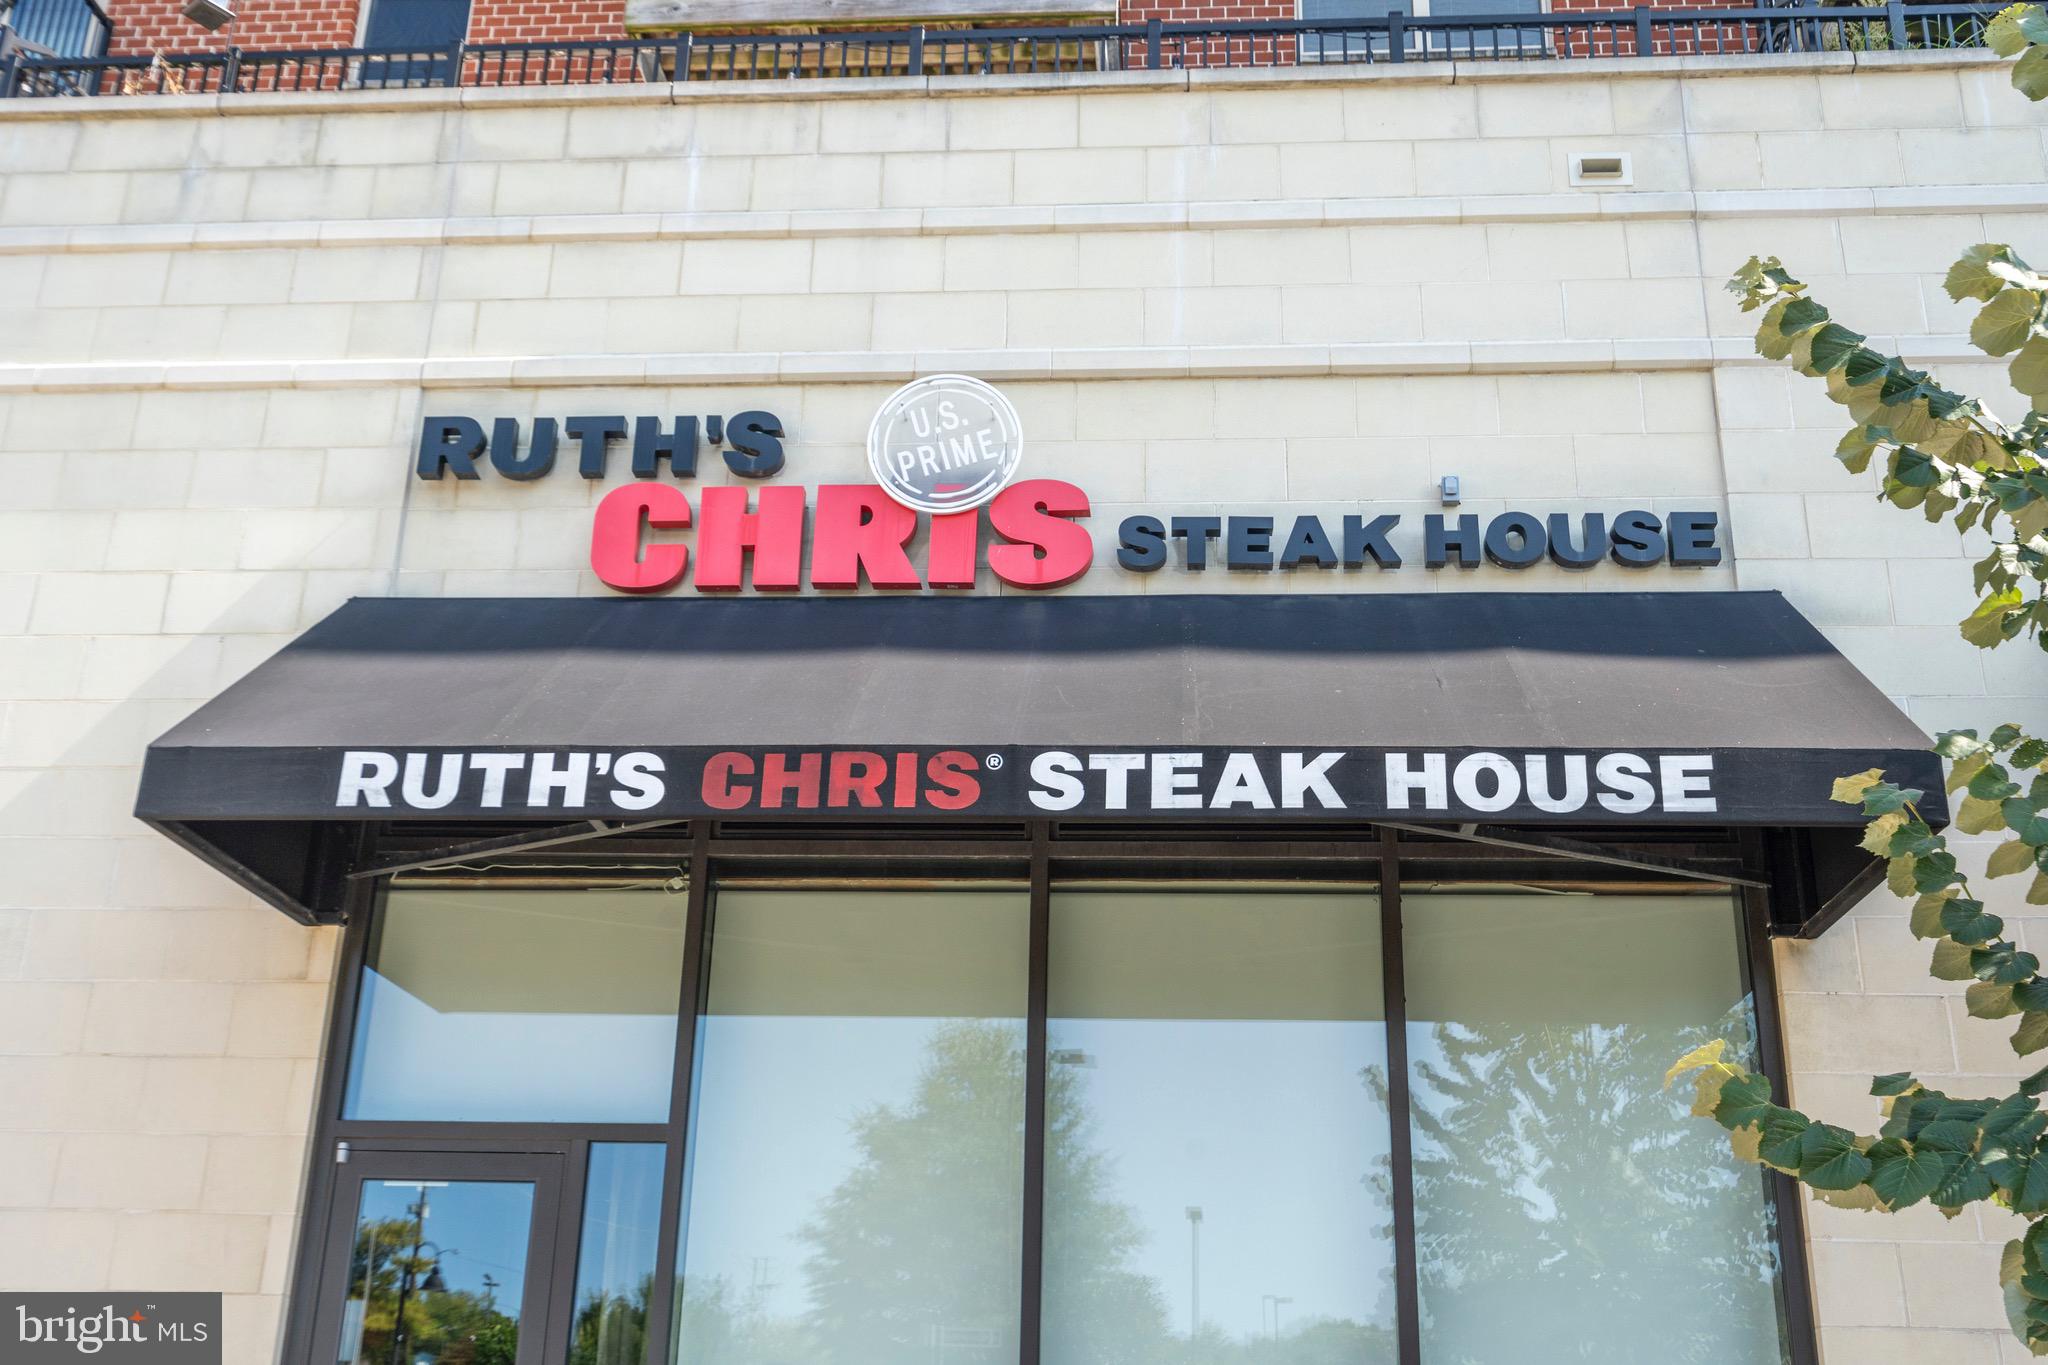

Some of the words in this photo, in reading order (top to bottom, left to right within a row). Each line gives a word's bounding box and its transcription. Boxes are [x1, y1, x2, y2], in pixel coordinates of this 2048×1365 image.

[417, 410, 786, 481] RUTH'S
[910, 401, 969, 438] U.S.
[897, 428, 999, 483] PRIME
[590, 478, 1092, 592] CHRIS
[1117, 514, 1402, 572] STEAK
[1424, 510, 1722, 569] HOUSE
[335, 751, 667, 811] RUTH’S
[1027, 751, 1348, 812] STEAK
[1384, 752, 1718, 814] HOUSE
